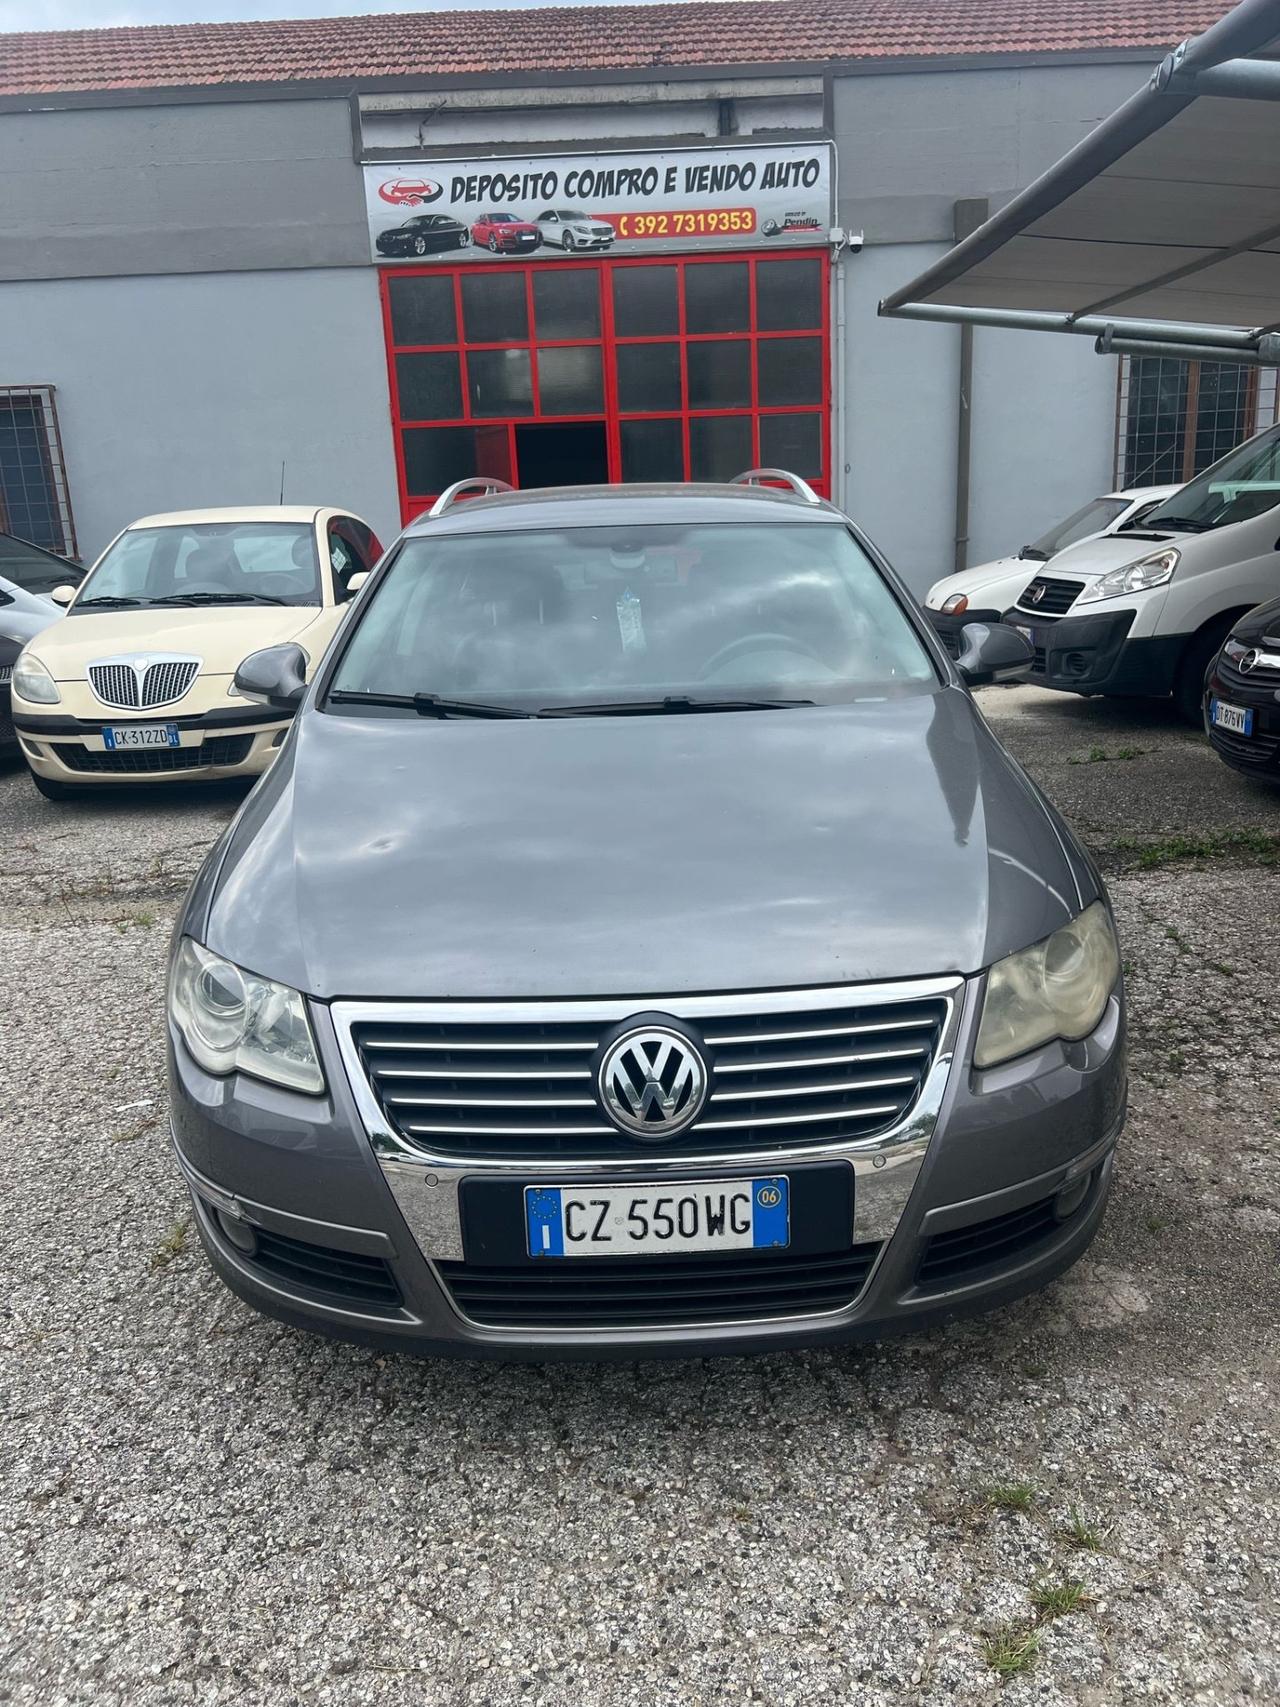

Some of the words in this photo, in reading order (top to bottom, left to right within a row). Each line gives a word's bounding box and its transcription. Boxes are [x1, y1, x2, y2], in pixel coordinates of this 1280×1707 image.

[450, 171, 557, 204] DEPOSITO
[564, 167, 658, 199] COMPRO
[664, 166, 677, 194] E
[685, 162, 756, 193] VENDO
[759, 158, 820, 190] AUTO
[634, 215, 668, 235] 392
[673, 211, 752, 233] 7319353
[608, 1034, 698, 1128] VW
[564, 1200, 611, 1242] CZ
[628, 1193, 751, 1241] 550WG
[761, 1190, 777, 1204] 06
